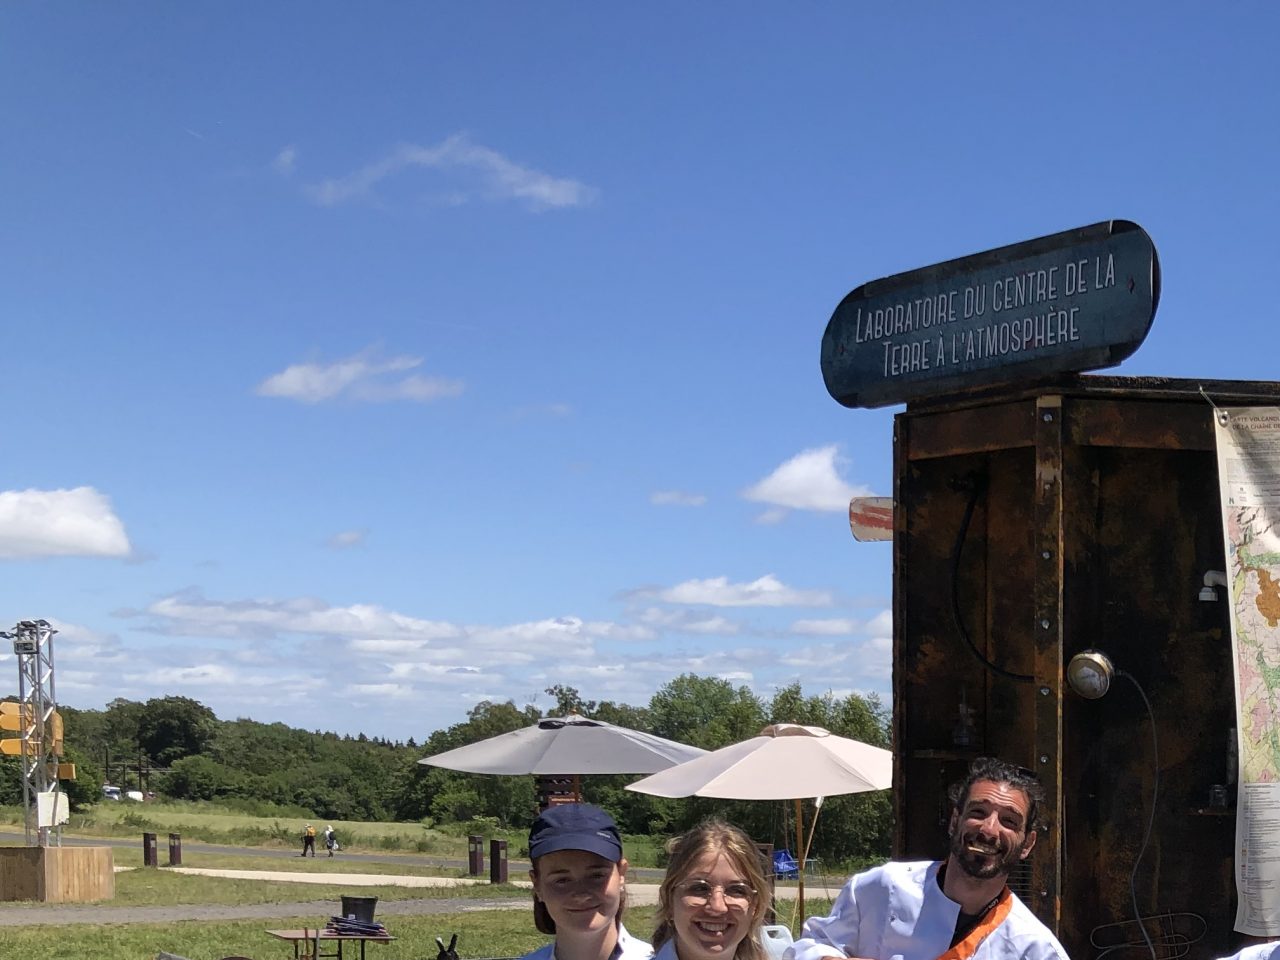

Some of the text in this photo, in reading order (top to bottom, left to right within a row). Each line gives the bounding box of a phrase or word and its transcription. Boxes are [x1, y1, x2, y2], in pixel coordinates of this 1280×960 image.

[855, 253, 1116, 344] LABORATOIRE DU CENTRE DE LA
[882, 306, 1080, 378] TERRE À L'ATMOSPHÈRE
